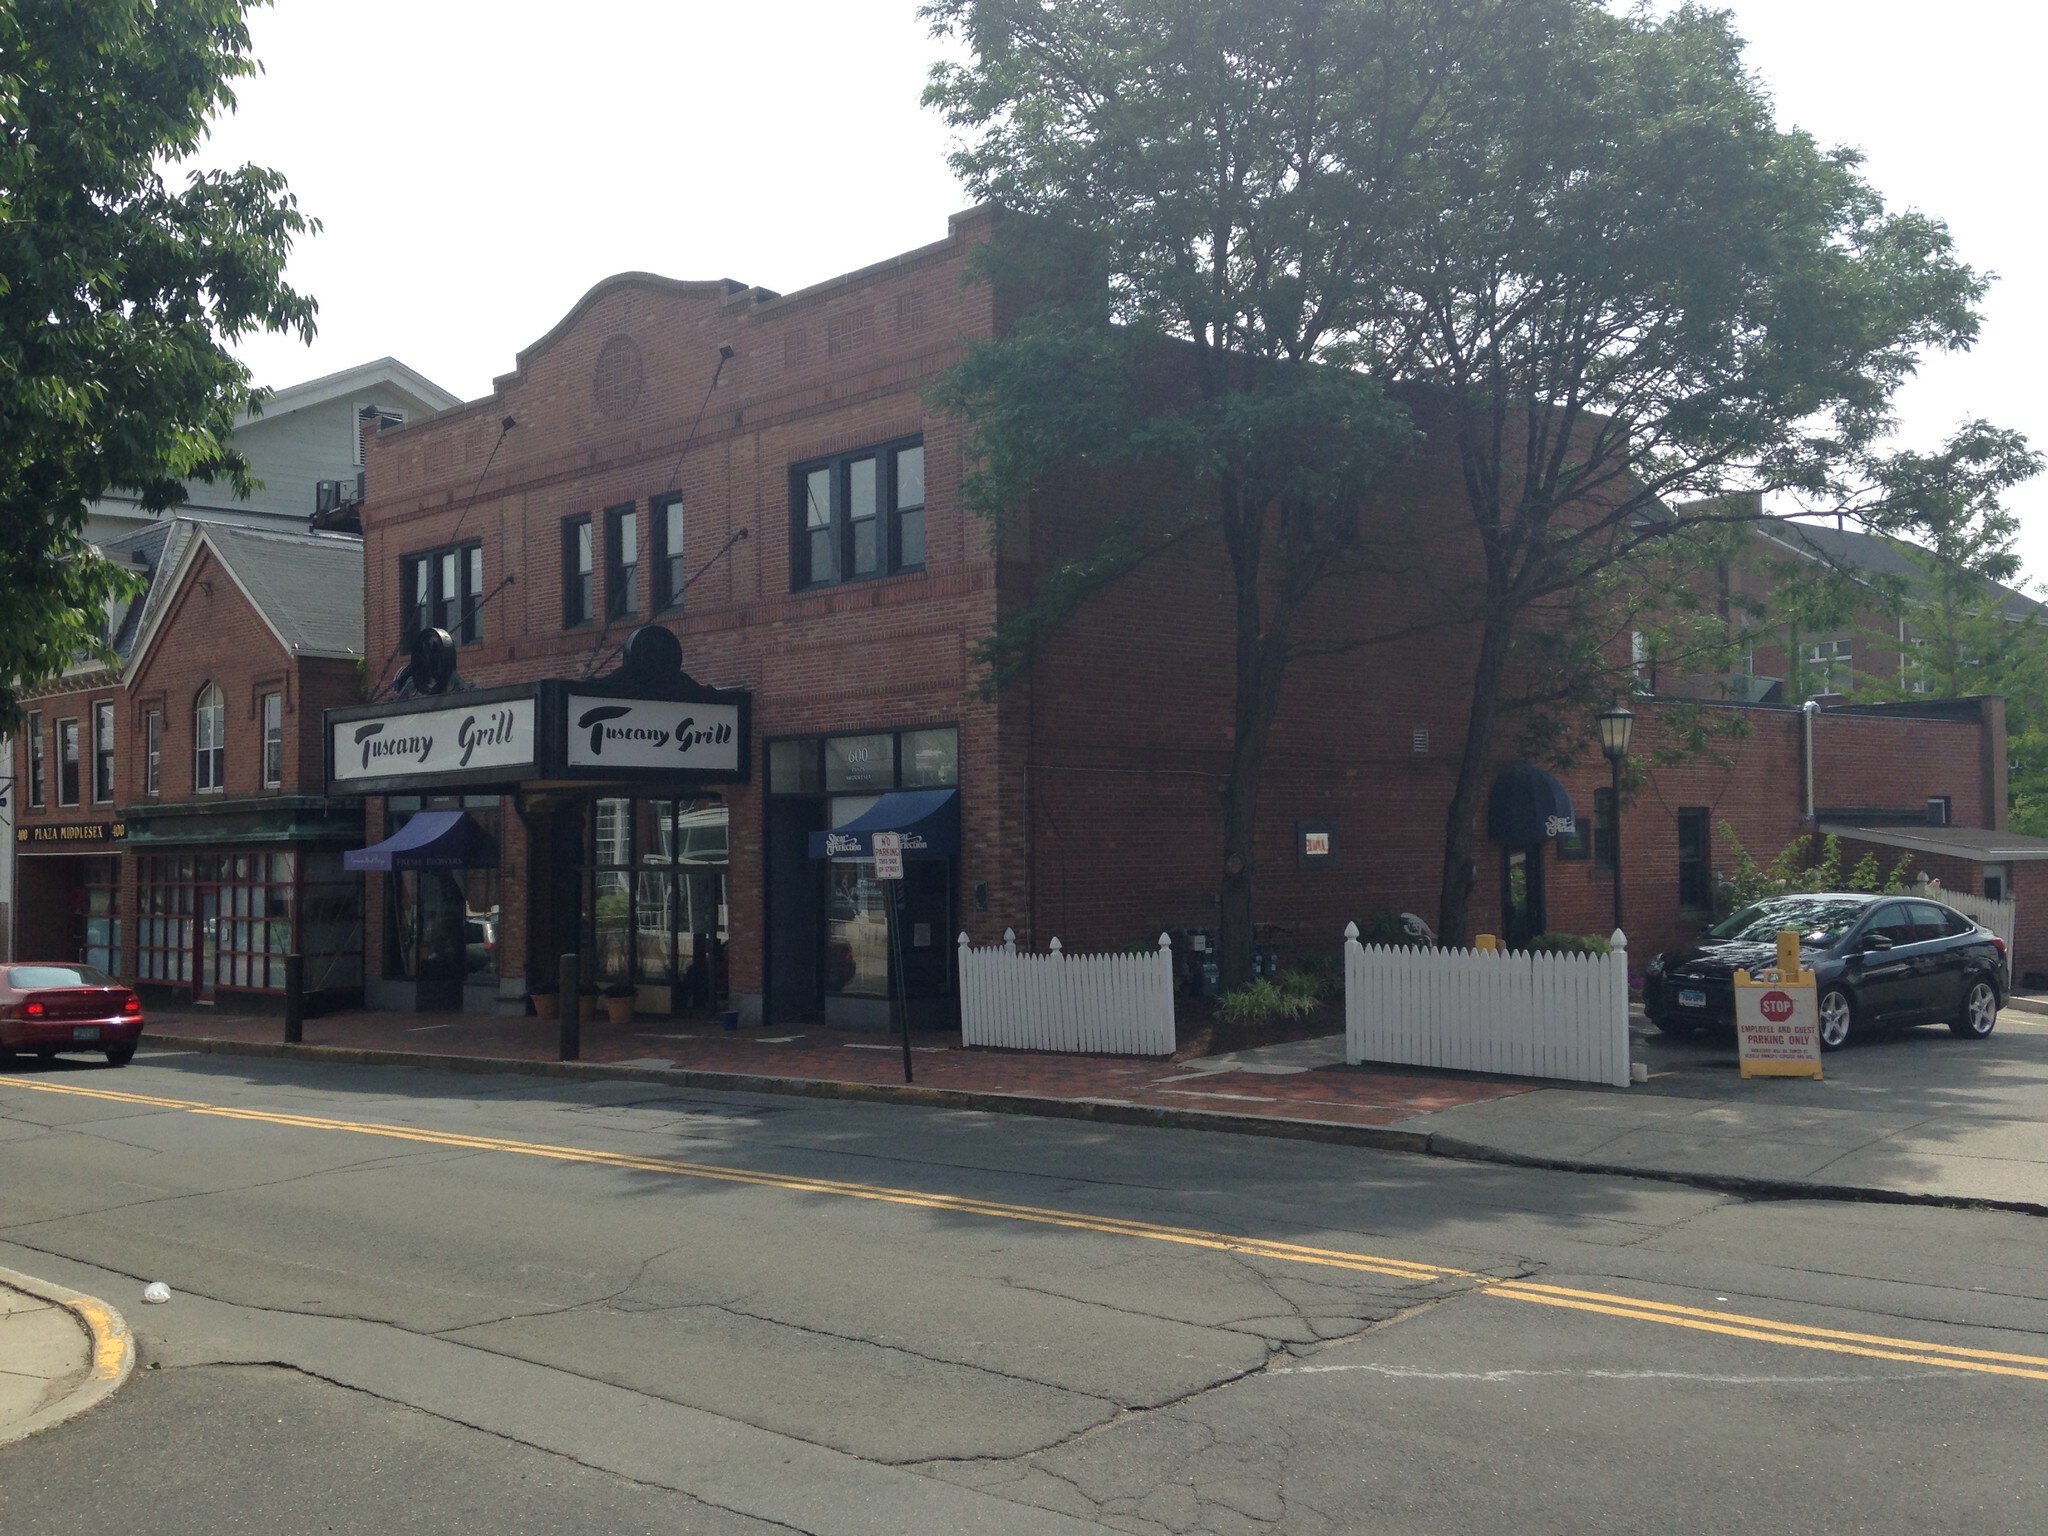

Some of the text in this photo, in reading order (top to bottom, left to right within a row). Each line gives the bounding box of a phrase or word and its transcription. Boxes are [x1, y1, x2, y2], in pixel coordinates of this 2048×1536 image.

[577, 706, 732, 755] Tuscany Grill
[354, 709, 514, 770] Tuscany Grill
[848, 747, 868, 763] 600
[17, 824, 125, 841] 400 PLAZA MIDDLESEX 400
[827, 833, 858, 844] Shear
[881, 837, 890, 846] NO
[875, 848, 899, 857] PARKING
[1763, 1000, 1790, 1013] STOP
[1741, 1025, 1815, 1034] EMPLOYEE AND GUEST
[1748, 1034, 1810, 1045] PARKING ONLY
